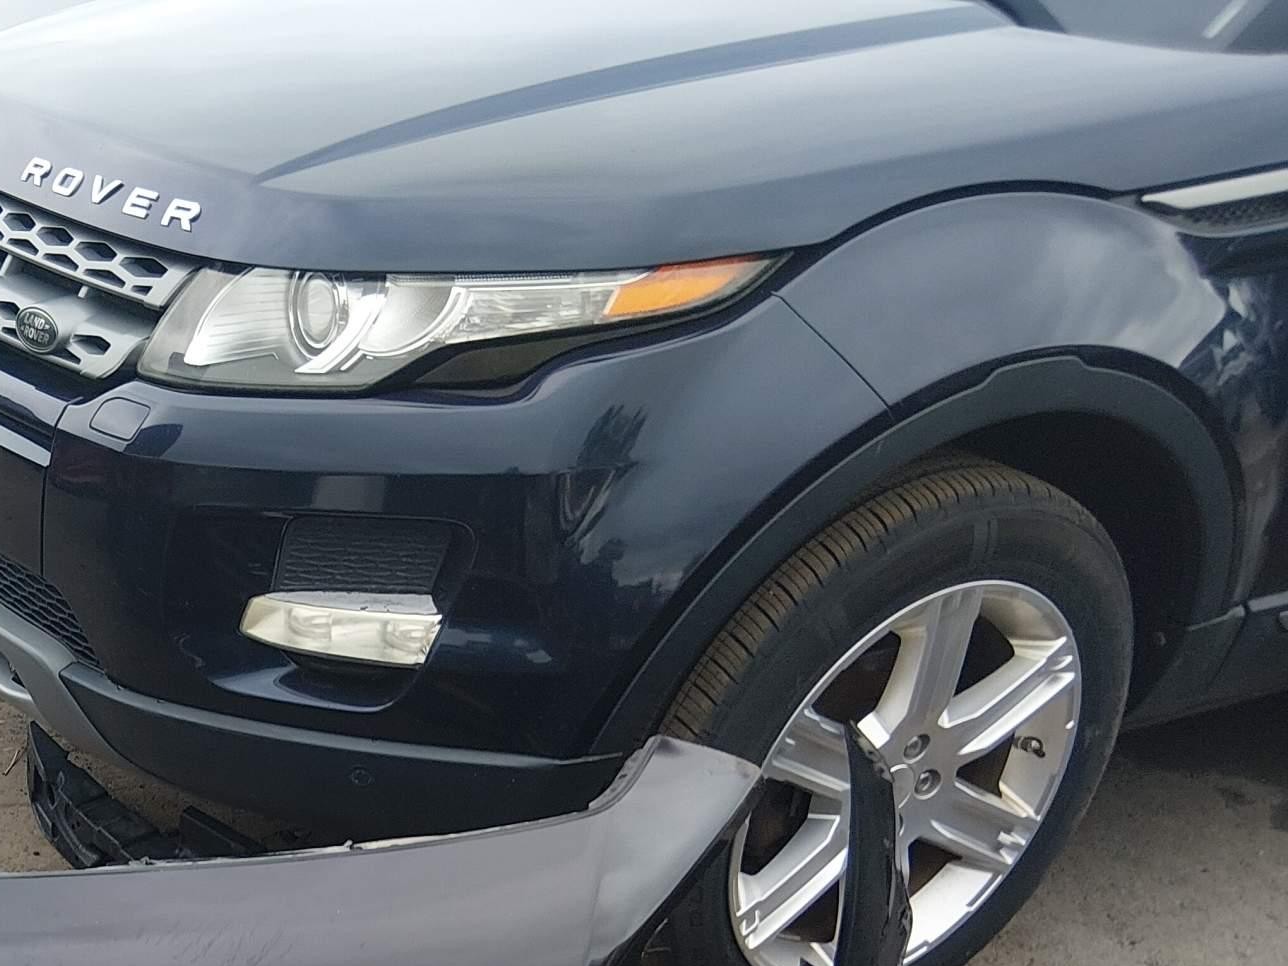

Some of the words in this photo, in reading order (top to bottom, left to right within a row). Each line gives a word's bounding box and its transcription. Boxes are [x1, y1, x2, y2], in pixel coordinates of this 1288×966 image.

[20, 156, 201, 232] ROVER
[24, 312, 46, 330] LAND
[23, 325, 50, 345] ROVER
